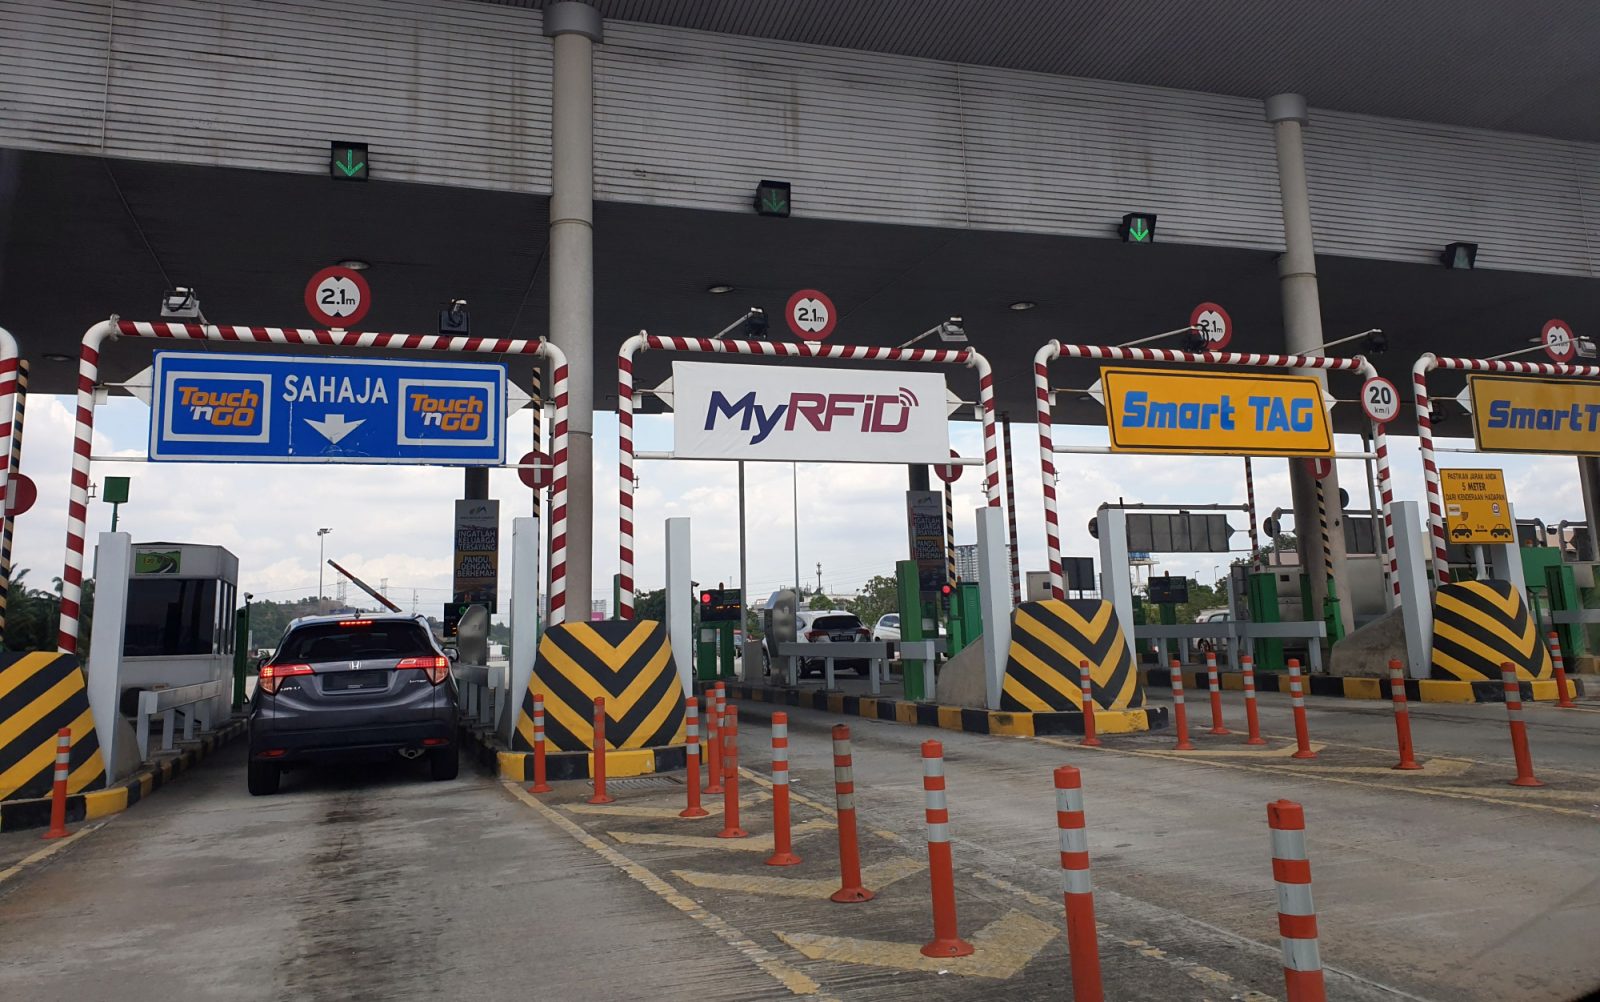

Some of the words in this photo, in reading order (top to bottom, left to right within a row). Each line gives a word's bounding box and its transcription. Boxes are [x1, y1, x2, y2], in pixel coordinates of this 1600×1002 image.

[321, 288, 356, 305] 2.1m
[798, 307, 825, 322] 2.1m
[178, 386, 260, 408] Touch
[282, 374, 389, 404] SAHAJA
[1369, 386, 1392, 405] 20
[410, 393, 484, 414] Touch
[1122, 391, 1236, 431] Smart
[1248, 396, 1314, 433] TAG
[1461, 482, 1467, 491] 5
[1467, 482, 1487, 491] METER
[457, 569, 496, 577] BERHEMAH
